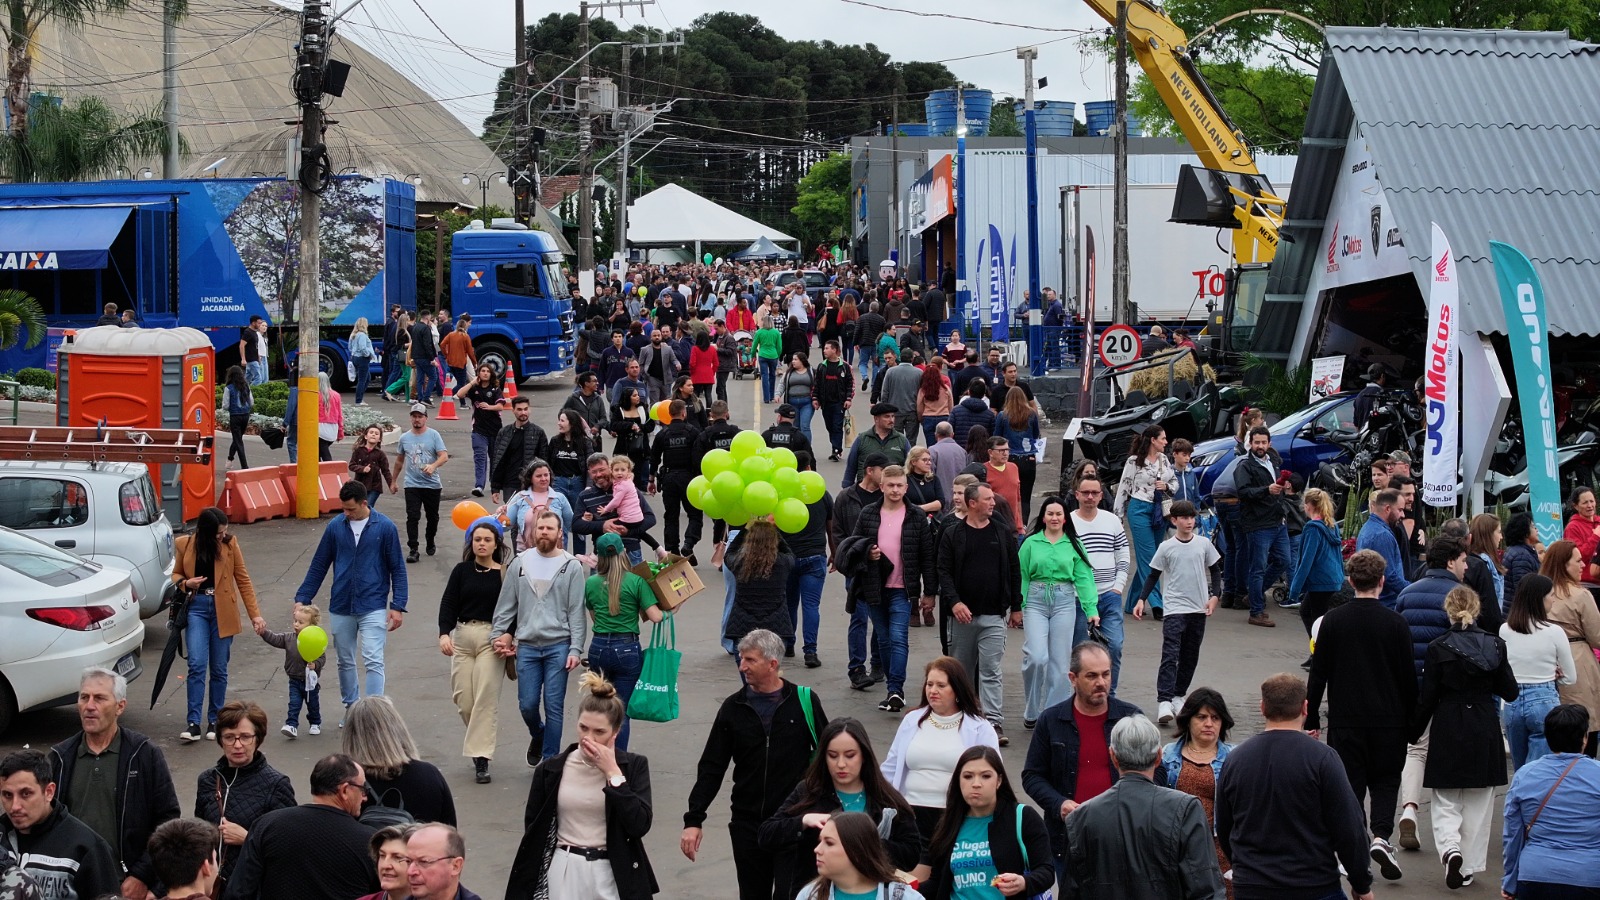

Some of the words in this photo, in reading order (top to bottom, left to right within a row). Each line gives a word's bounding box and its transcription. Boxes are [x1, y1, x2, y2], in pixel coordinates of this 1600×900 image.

[1170, 71, 1191, 100] NEW
[1189, 99, 1228, 154] HOLLAND
[1258, 226, 1274, 243] NEW
[0, 252, 59, 270] AIXA
[200, 296, 233, 304] UNIDADE
[200, 303, 246, 312] JACARANDÁ
[1105, 334, 1133, 354] 20
[1110, 354, 1128, 362] km/h
[1425, 303, 1451, 455] JGMotos
[669, 437, 687, 446] NOT
[715, 438, 732, 448] NOT
[772, 433, 790, 442] NOT
[950, 850, 974, 863] para
[960, 871, 987, 884] UNO
